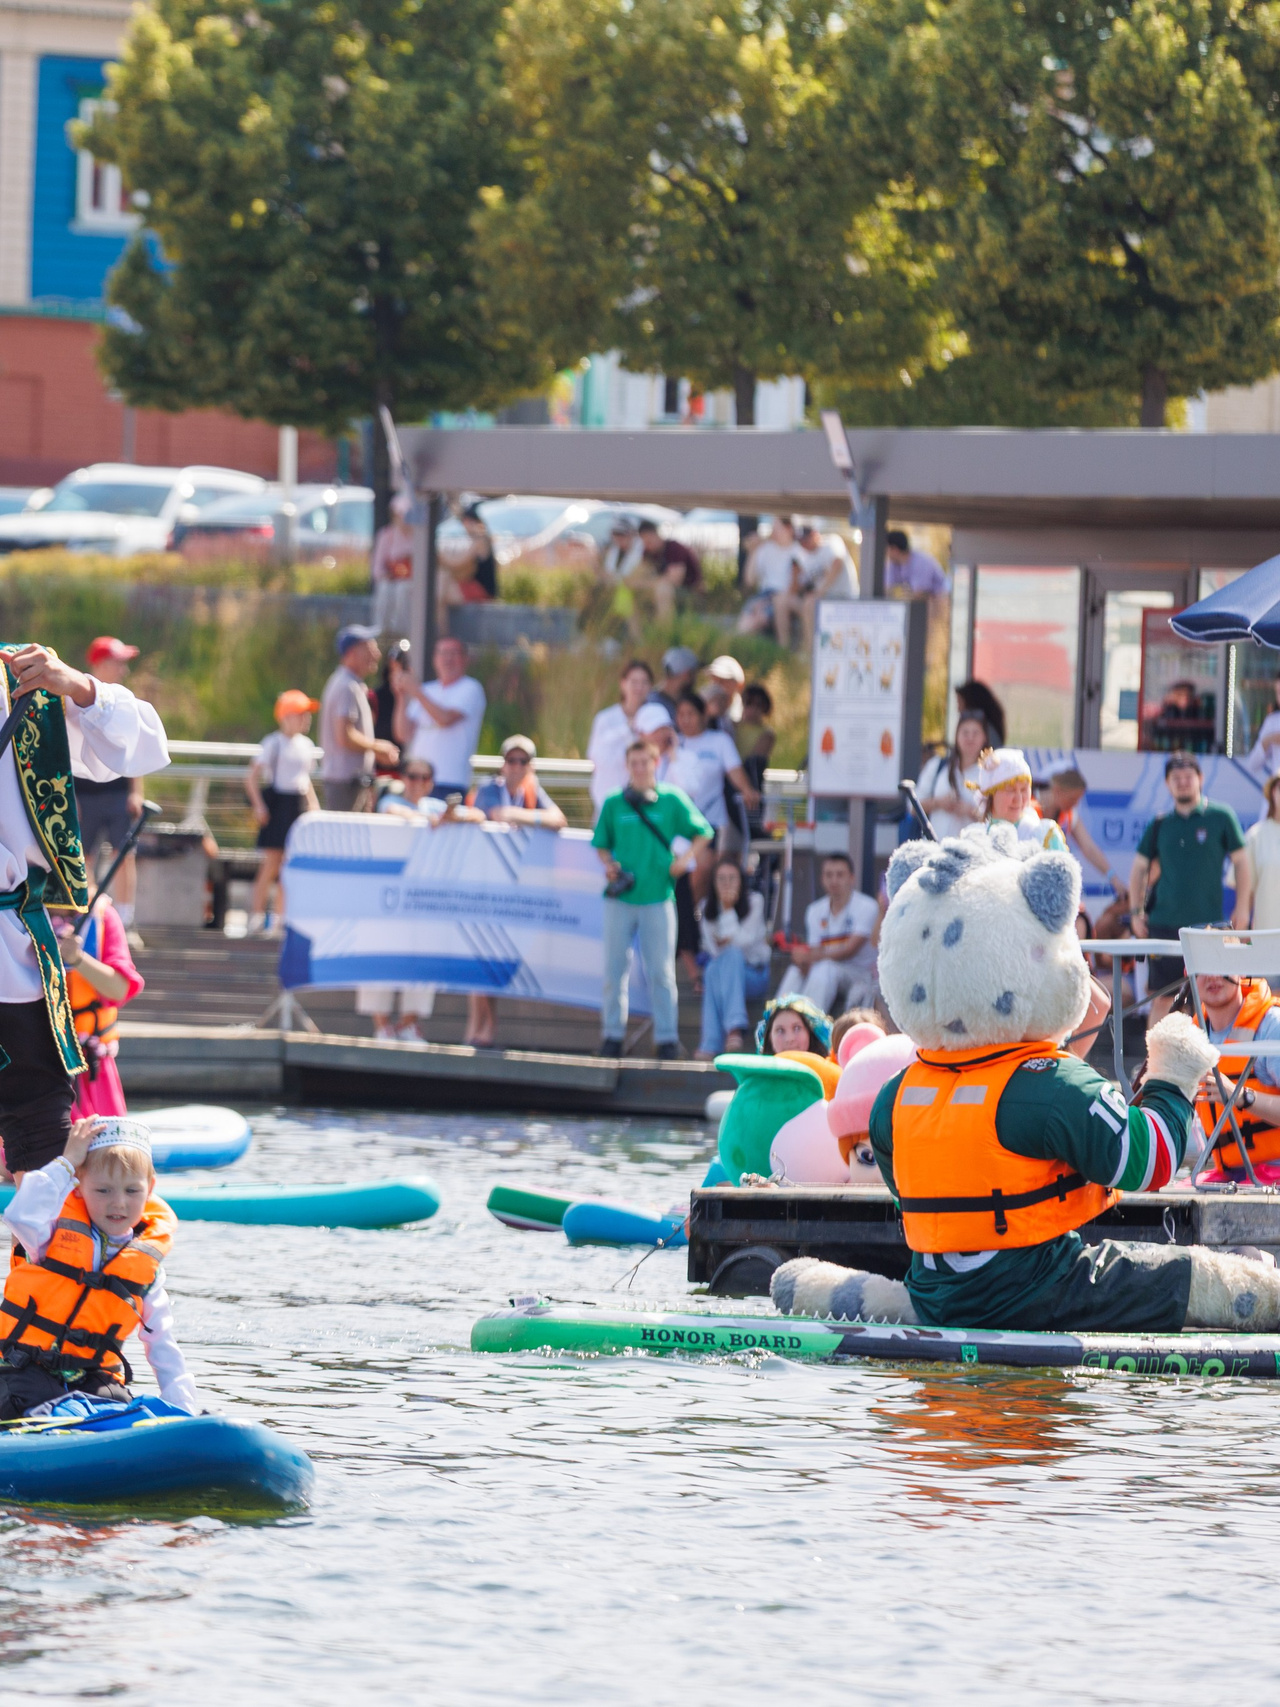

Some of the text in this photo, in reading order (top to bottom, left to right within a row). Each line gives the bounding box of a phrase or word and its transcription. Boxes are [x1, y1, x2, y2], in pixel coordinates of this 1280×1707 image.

[1089, 1082, 1128, 1135] 16
[641, 1328, 802, 1349] HONOR BOARD
